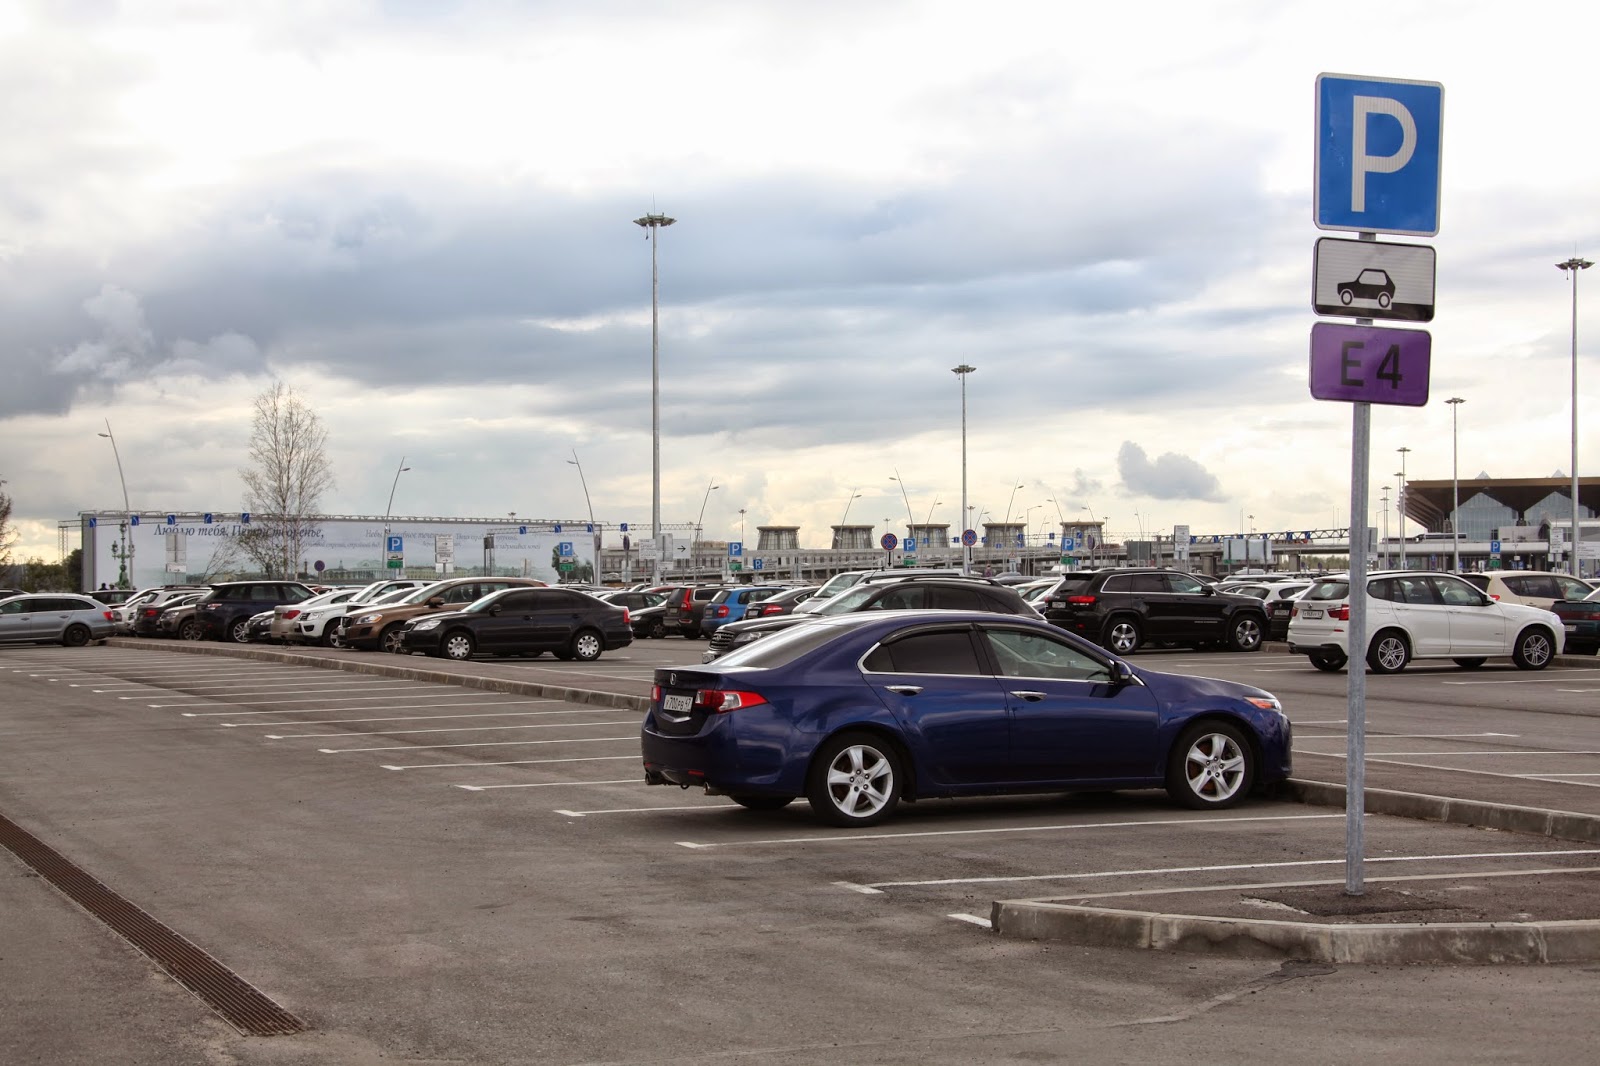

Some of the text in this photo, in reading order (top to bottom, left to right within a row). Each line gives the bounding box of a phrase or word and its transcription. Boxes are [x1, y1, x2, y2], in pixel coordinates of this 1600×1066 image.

[1351, 94, 1417, 213] P
[391, 538, 400, 550] P
[562, 543, 571, 555] P
[732, 543, 740, 555] P
[907, 540, 914, 550] P
[1064, 539, 1072, 549] P
[1493, 542, 1499, 552] P
